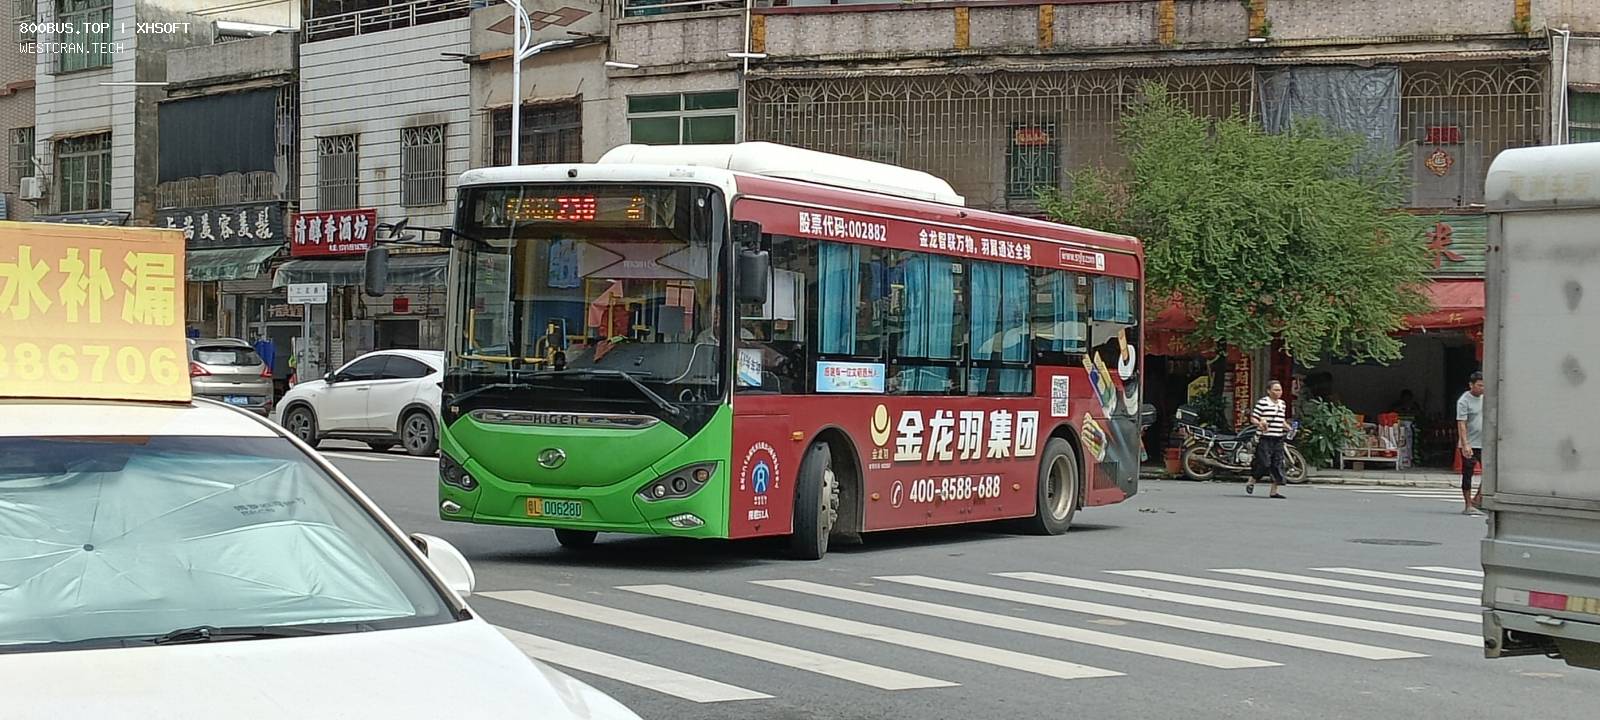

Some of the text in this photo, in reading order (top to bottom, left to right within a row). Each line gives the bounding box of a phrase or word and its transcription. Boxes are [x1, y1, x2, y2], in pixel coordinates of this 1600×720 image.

[799, 211, 887, 242] 股票代码:002882
[0, 245, 176, 326] 水补漏
[533, 413, 578, 425] HIGER
[894, 410, 1040, 462] 金龙羽集团
[909, 475, 1001, 503] 400-8588-688
